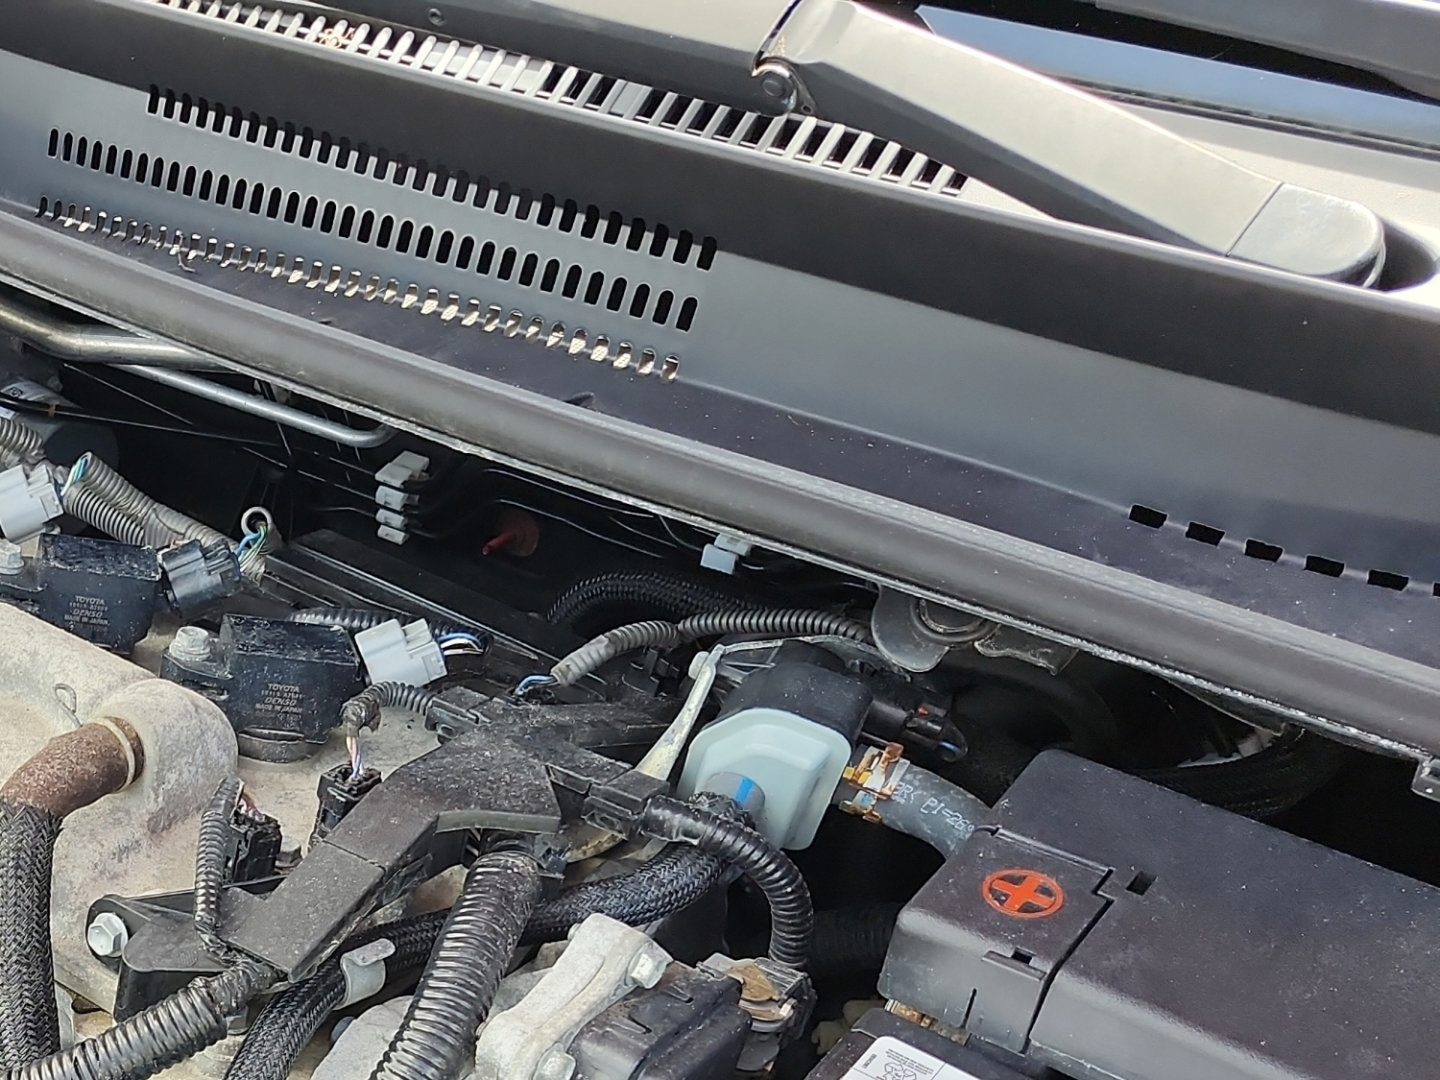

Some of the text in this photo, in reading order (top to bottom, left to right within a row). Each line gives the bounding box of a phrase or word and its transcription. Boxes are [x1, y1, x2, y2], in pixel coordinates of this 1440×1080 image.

[74, 596, 105, 606] TOYOTA
[72, 608, 103, 618] DENSO
[268, 683, 299, 693] TOYOTA
[264, 697, 297, 706] DENSO
